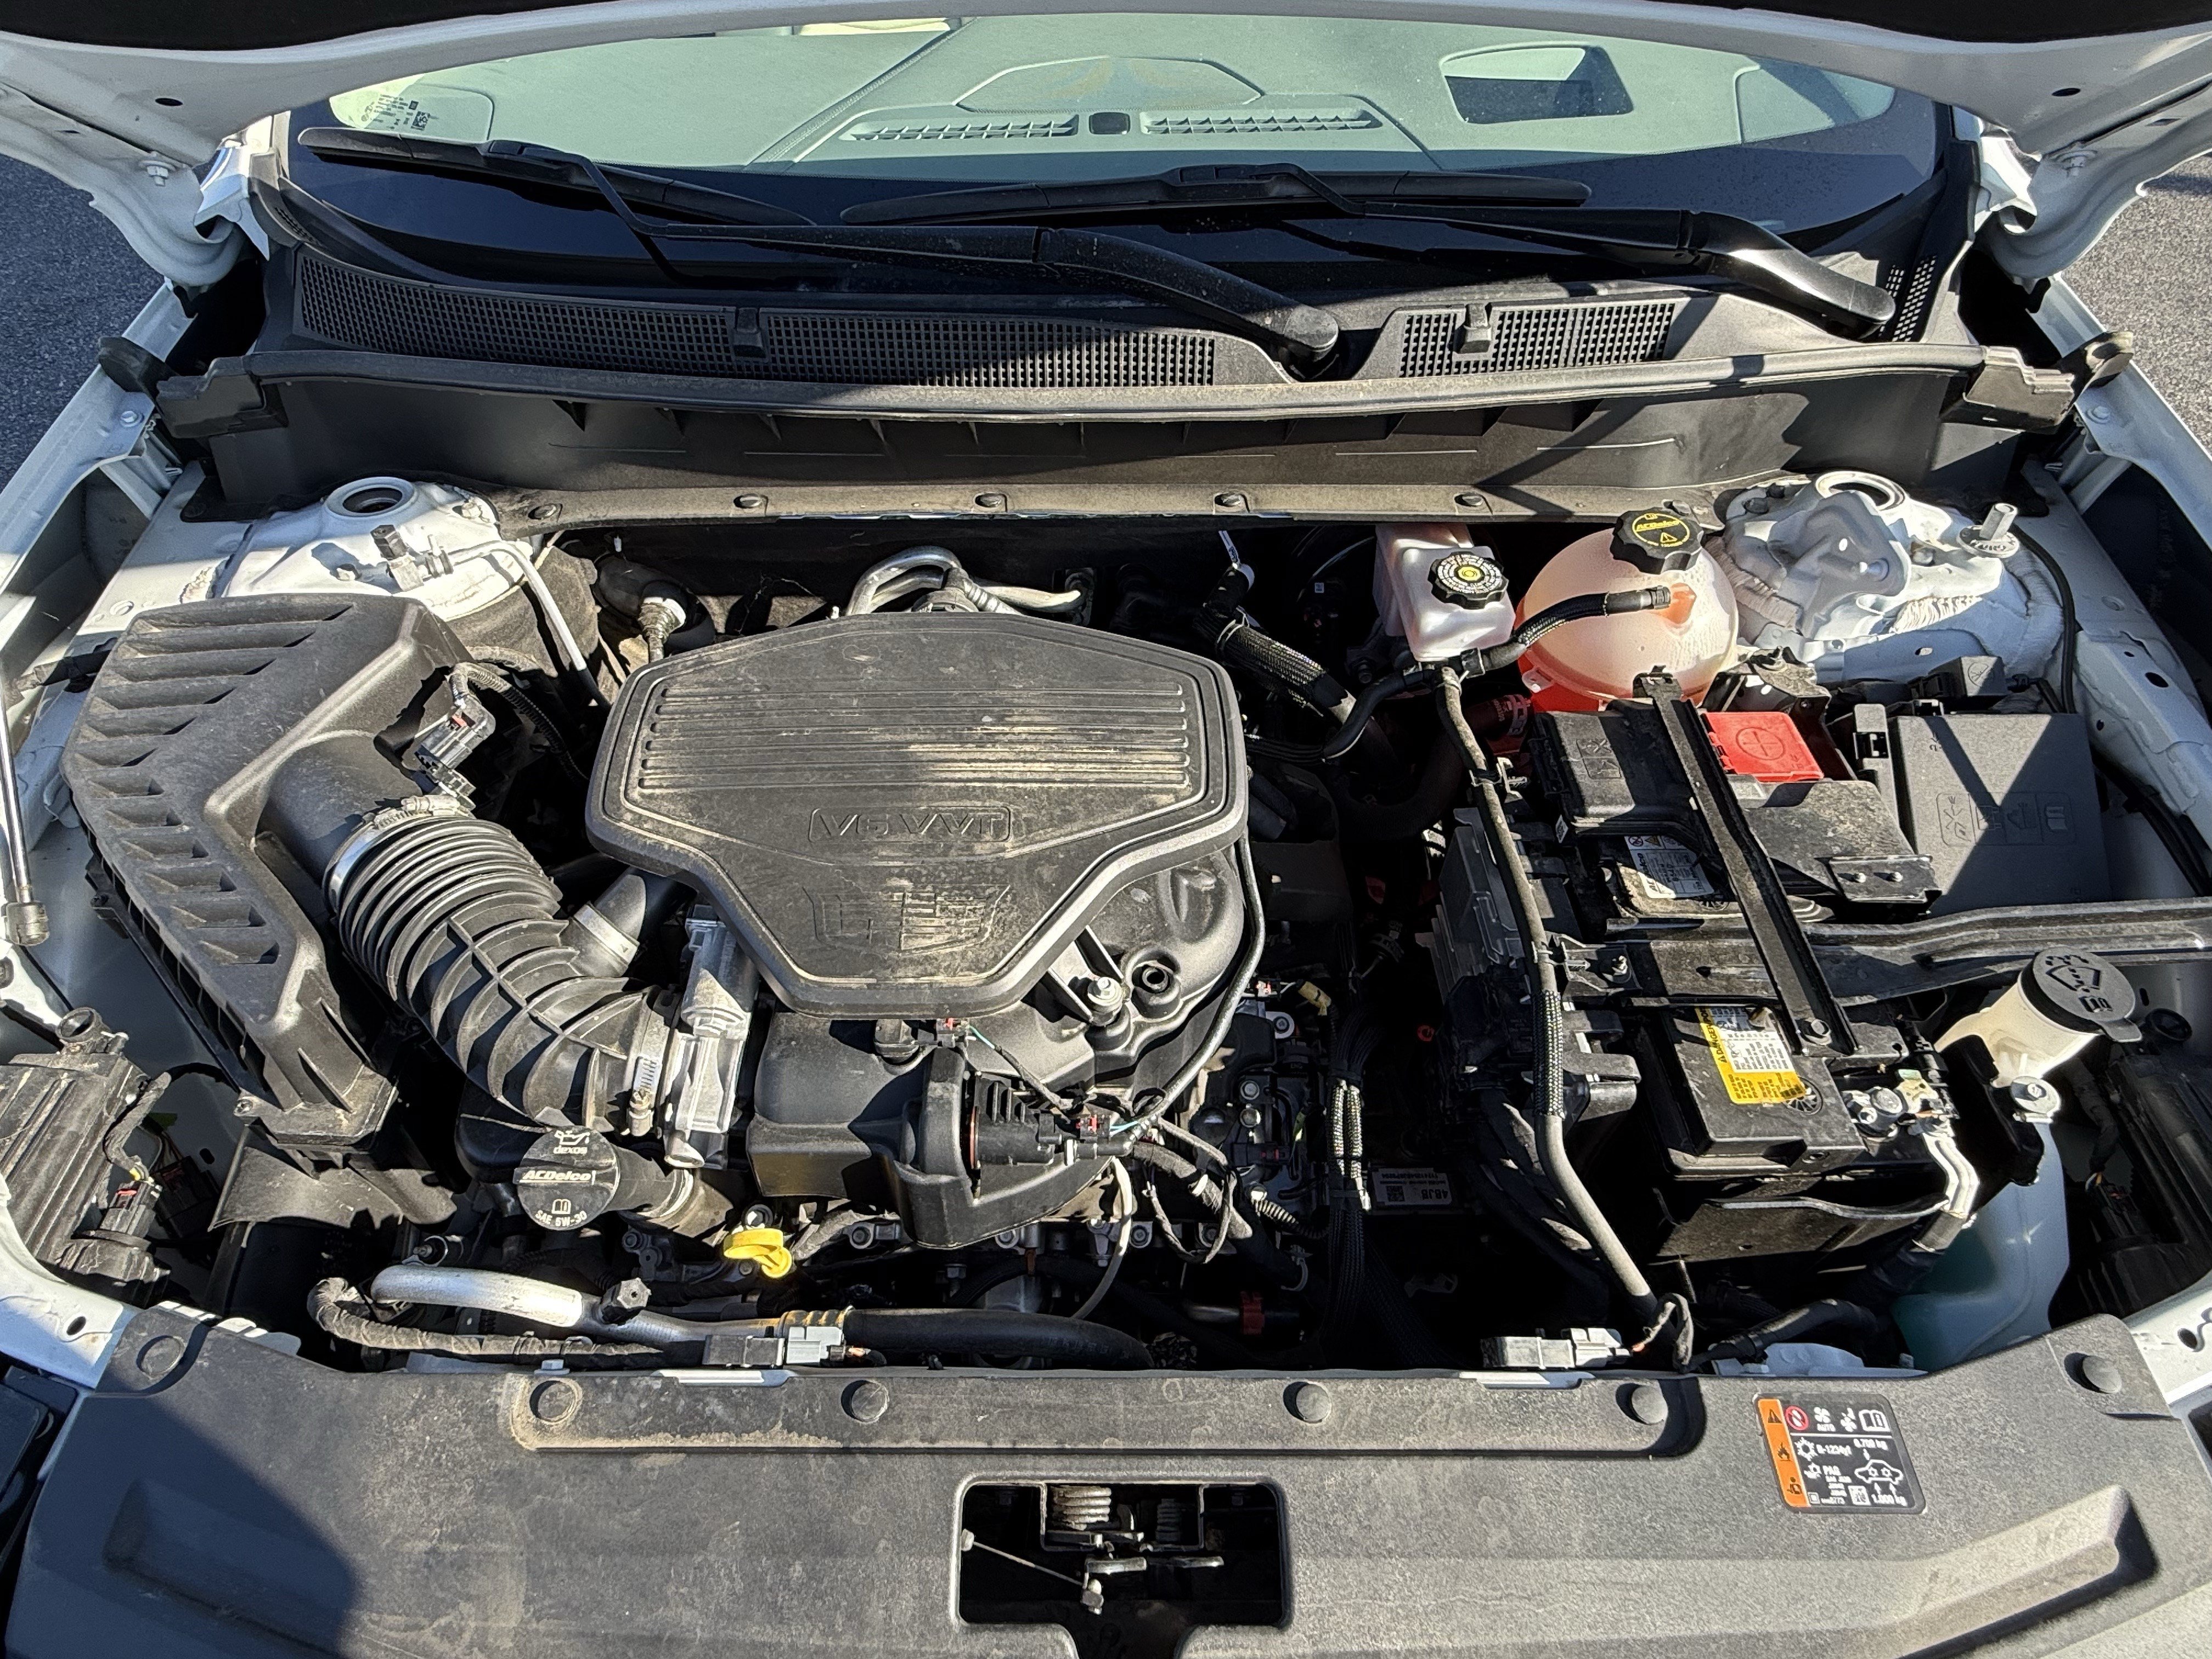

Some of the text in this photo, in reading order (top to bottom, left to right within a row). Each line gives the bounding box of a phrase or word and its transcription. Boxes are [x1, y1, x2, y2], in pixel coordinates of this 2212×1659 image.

[820, 812, 1005, 836] V6 VVT
[522, 1170, 591, 1181] ACDelco
[534, 1209, 588, 1227] SAE 5W-30
[1817, 1423, 1836, 1432] AUTO
